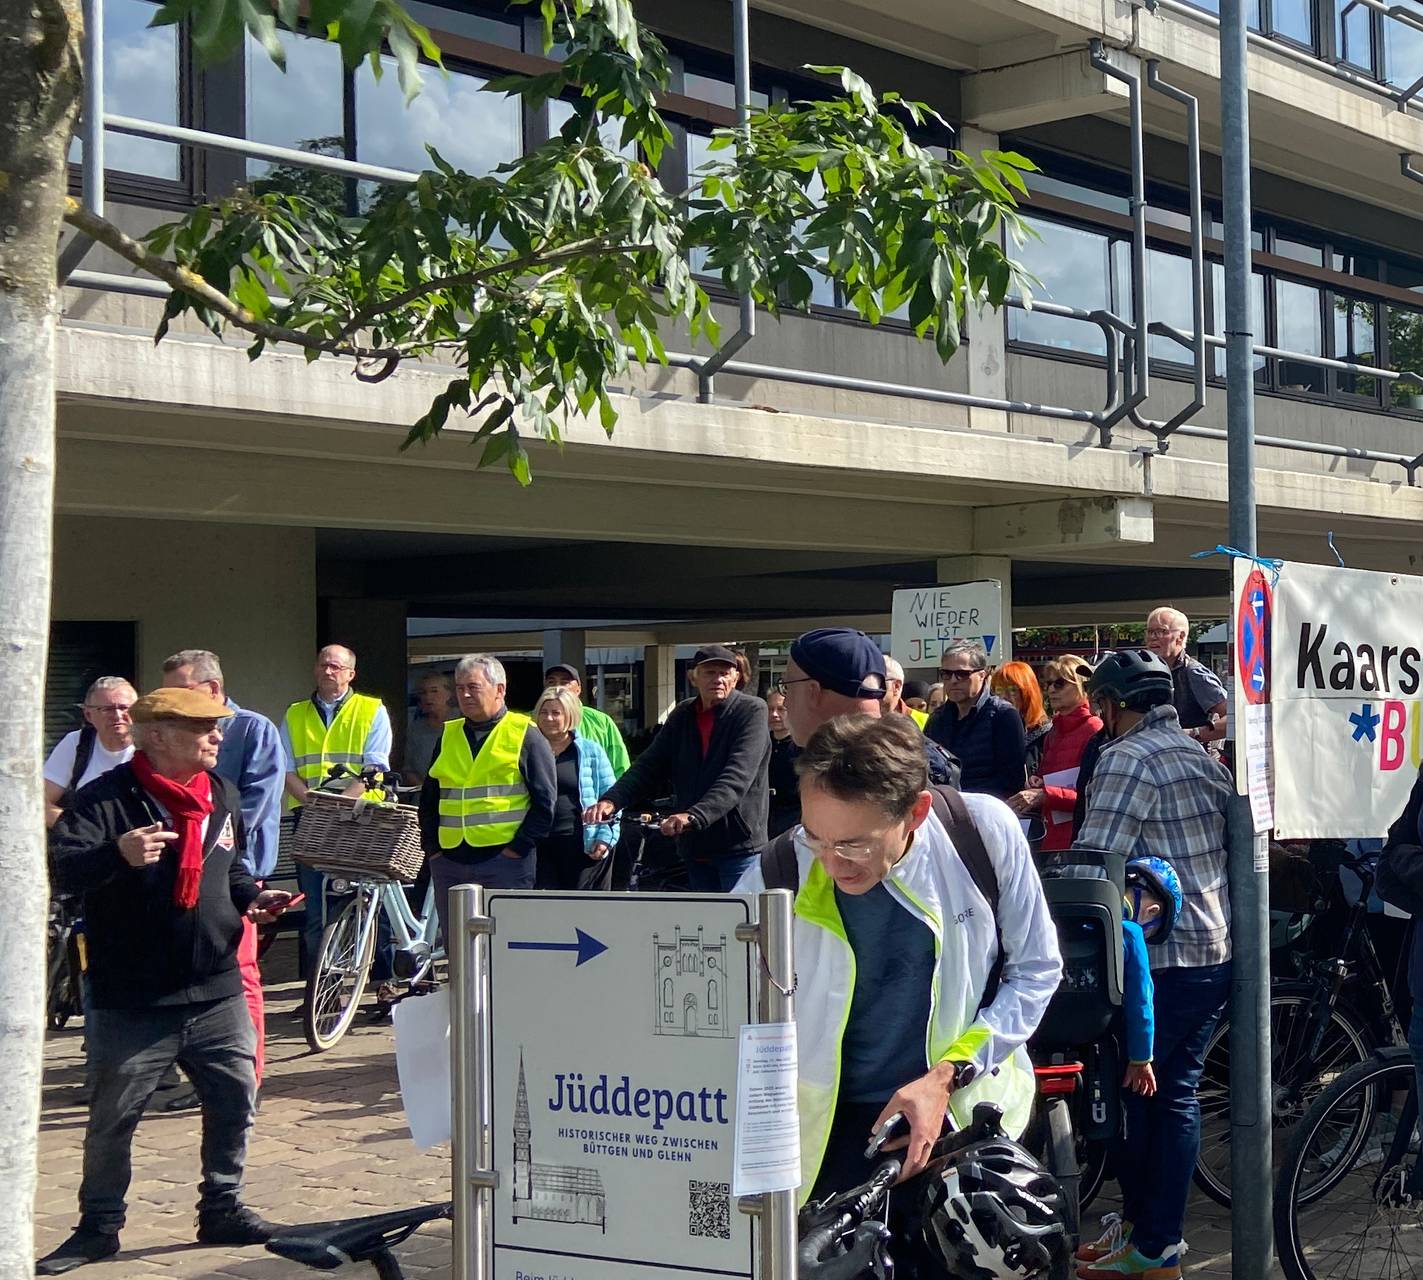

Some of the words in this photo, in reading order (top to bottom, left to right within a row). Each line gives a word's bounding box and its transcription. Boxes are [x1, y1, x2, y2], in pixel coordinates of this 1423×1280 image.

[909, 592, 951, 612] NIE
[915, 608, 980, 628] WIEDER
[937, 626, 961, 638] IST
[549, 1072, 729, 1130] Jüddepatt
[558, 1127, 631, 1143] HISTORISCHER
[635, 1134, 658, 1146] WEG
[662, 1136, 718, 1151] ZWISCHEN
[583, 1142, 628, 1157] BÜTTGEN
[632, 1147, 653, 1159] UND
[658, 1150, 692, 1163] GLEHN
